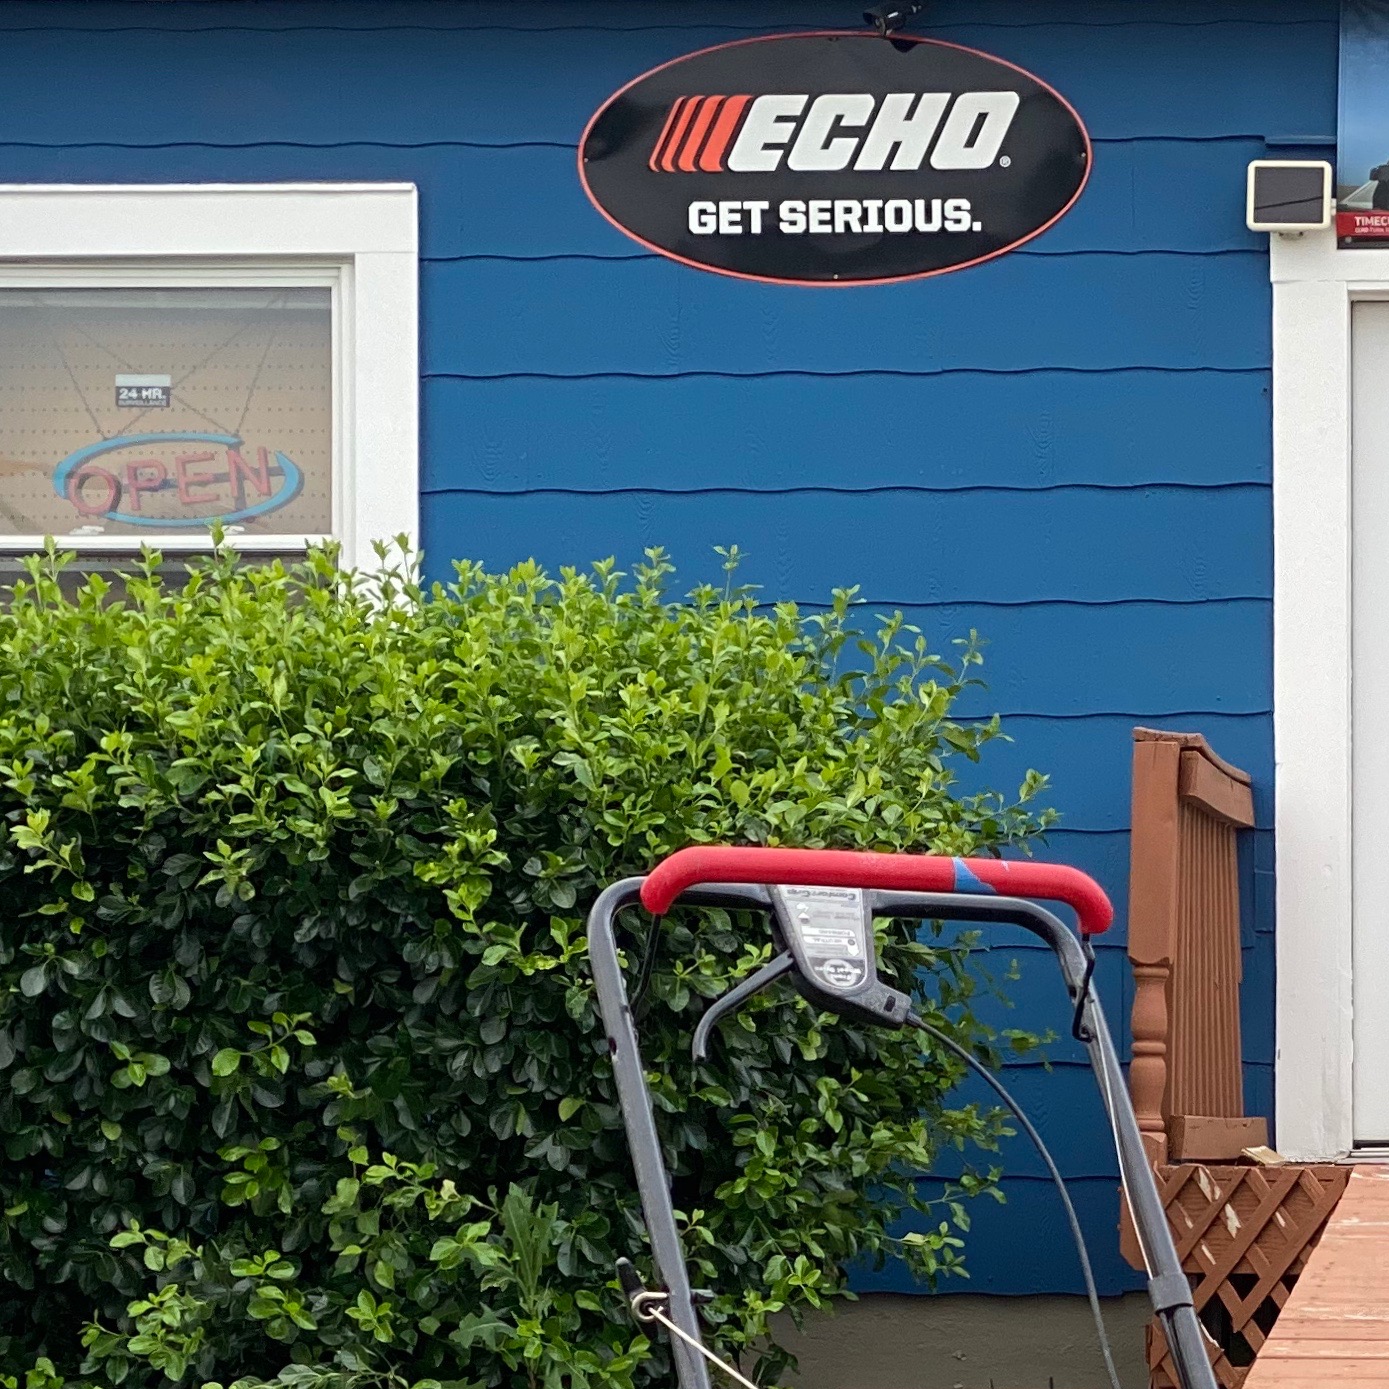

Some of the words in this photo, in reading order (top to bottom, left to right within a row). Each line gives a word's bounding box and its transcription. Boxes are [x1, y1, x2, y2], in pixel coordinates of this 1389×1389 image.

[728, 91, 1020, 172] ECHO
[688, 201, 770, 235] GET
[778, 199, 982, 234] SERIOUS.
[119, 387, 138, 399] 24
[66, 446, 272, 516] OPEN
